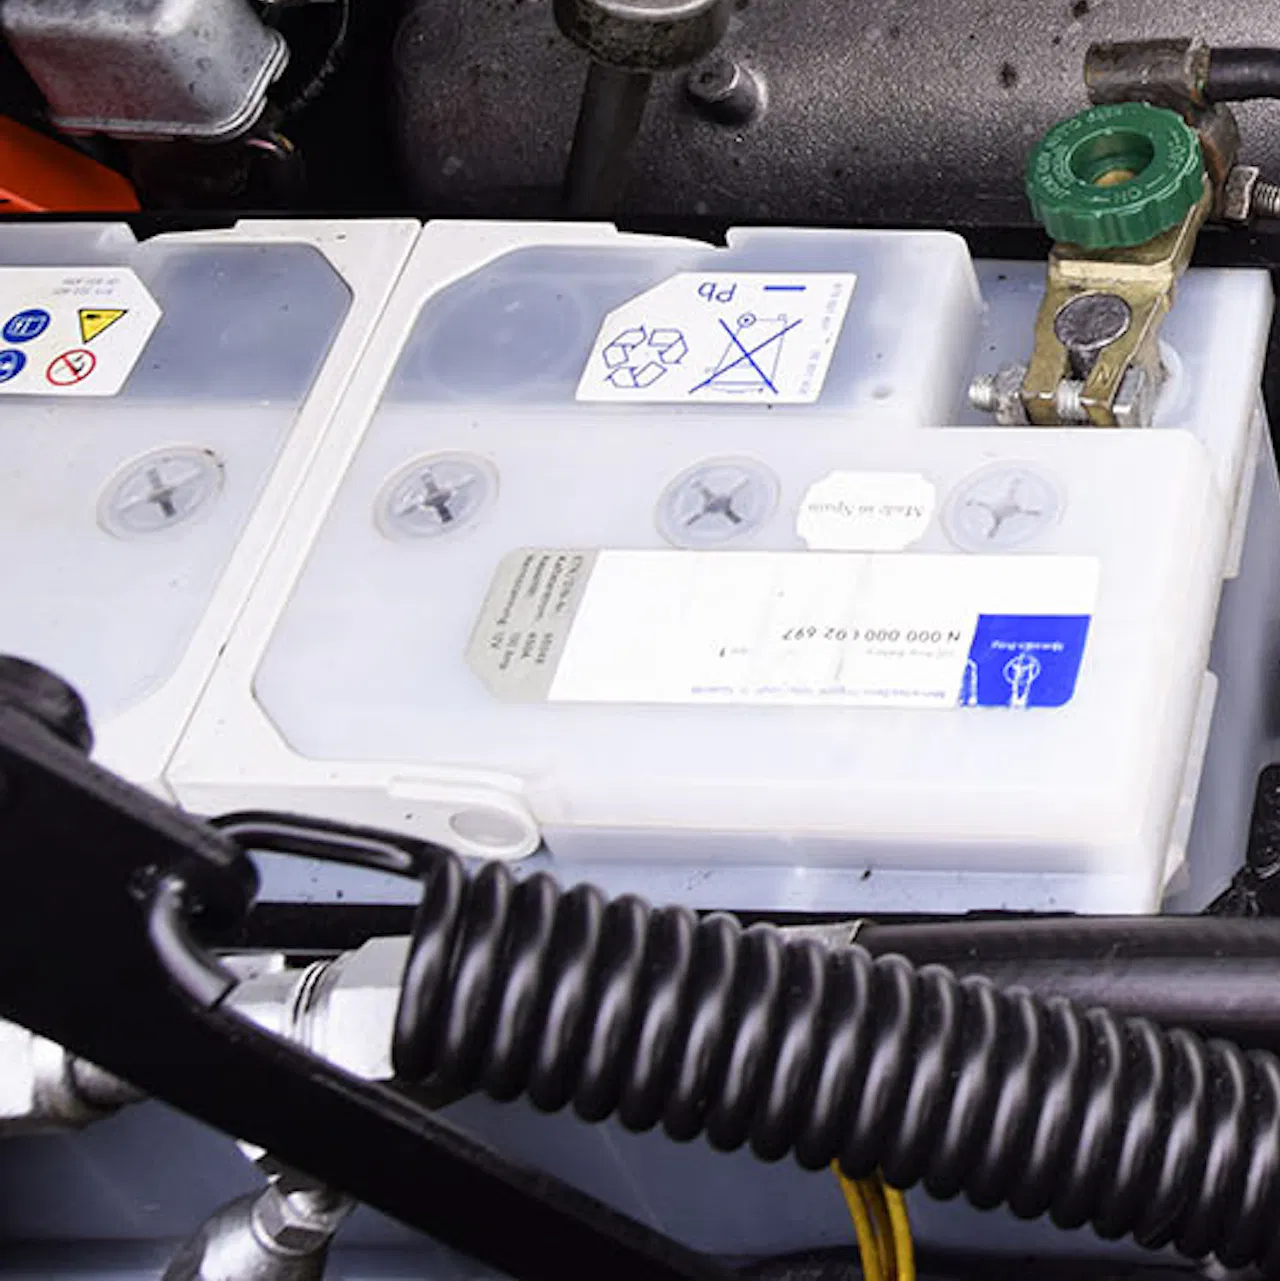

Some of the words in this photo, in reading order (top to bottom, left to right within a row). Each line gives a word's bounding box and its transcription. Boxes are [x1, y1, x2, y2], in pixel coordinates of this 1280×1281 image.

[697, 282, 738, 304] Pb
[781, 624, 818, 641] 697
[864, 629, 901, 642] 000
[906, 630, 943, 642] 000
[946, 630, 961, 643] N
